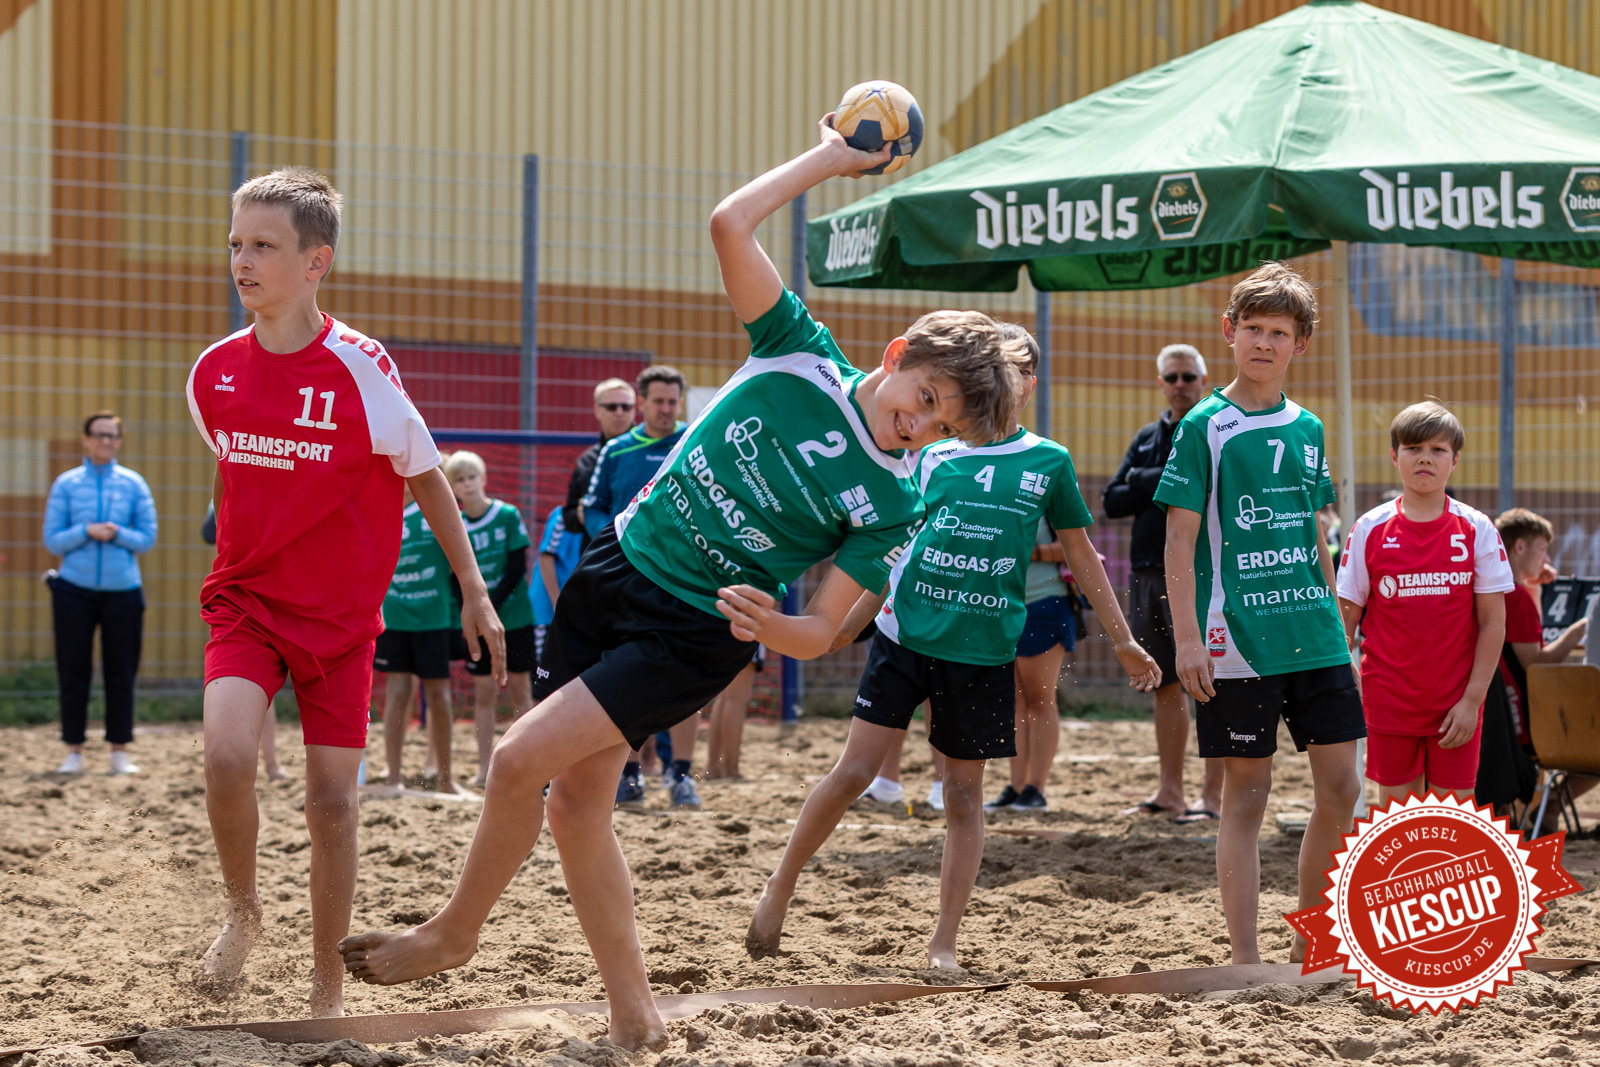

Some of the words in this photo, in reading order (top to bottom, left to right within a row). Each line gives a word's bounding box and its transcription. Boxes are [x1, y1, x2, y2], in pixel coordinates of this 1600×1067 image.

[214, 384, 235, 392] erima
[293, 386, 337, 431] 11
[231, 431, 333, 463] TEAMSPORT
[796, 430, 848, 468] 2
[1267, 438, 1286, 474] 7
[228, 451, 295, 471] NIEDERRHEIN
[688, 444, 746, 529] ERDGAS
[735, 457, 770, 509] Langenfeld
[747, 461, 782, 513] Stadtwerke
[974, 465, 996, 492] 4
[694, 487, 712, 510] mobil
[1267, 519, 1304, 531] Langenfeld
[1274, 510, 1312, 521] Stadtwerke
[951, 528, 995, 541] Langenfeld
[960, 522, 1004, 535] Stadtwerke
[922, 546, 990, 573] ERDGAS
[1237, 546, 1308, 571] ERDGAS
[1450, 533, 1469, 562] 5
[945, 569, 965, 579] mobil
[1239, 570, 1273, 580] Natürlich
[1273, 566, 1294, 576] mobil
[1397, 571, 1472, 588] TEAMSPORT
[914, 581, 1008, 609] markoon
[1398, 586, 1450, 597] NIEDERRHEIN
[921, 597, 1001, 618] WERBEAGENTUR
[1547, 592, 1569, 622] 4
[1230, 731, 1256, 743] Kempa
